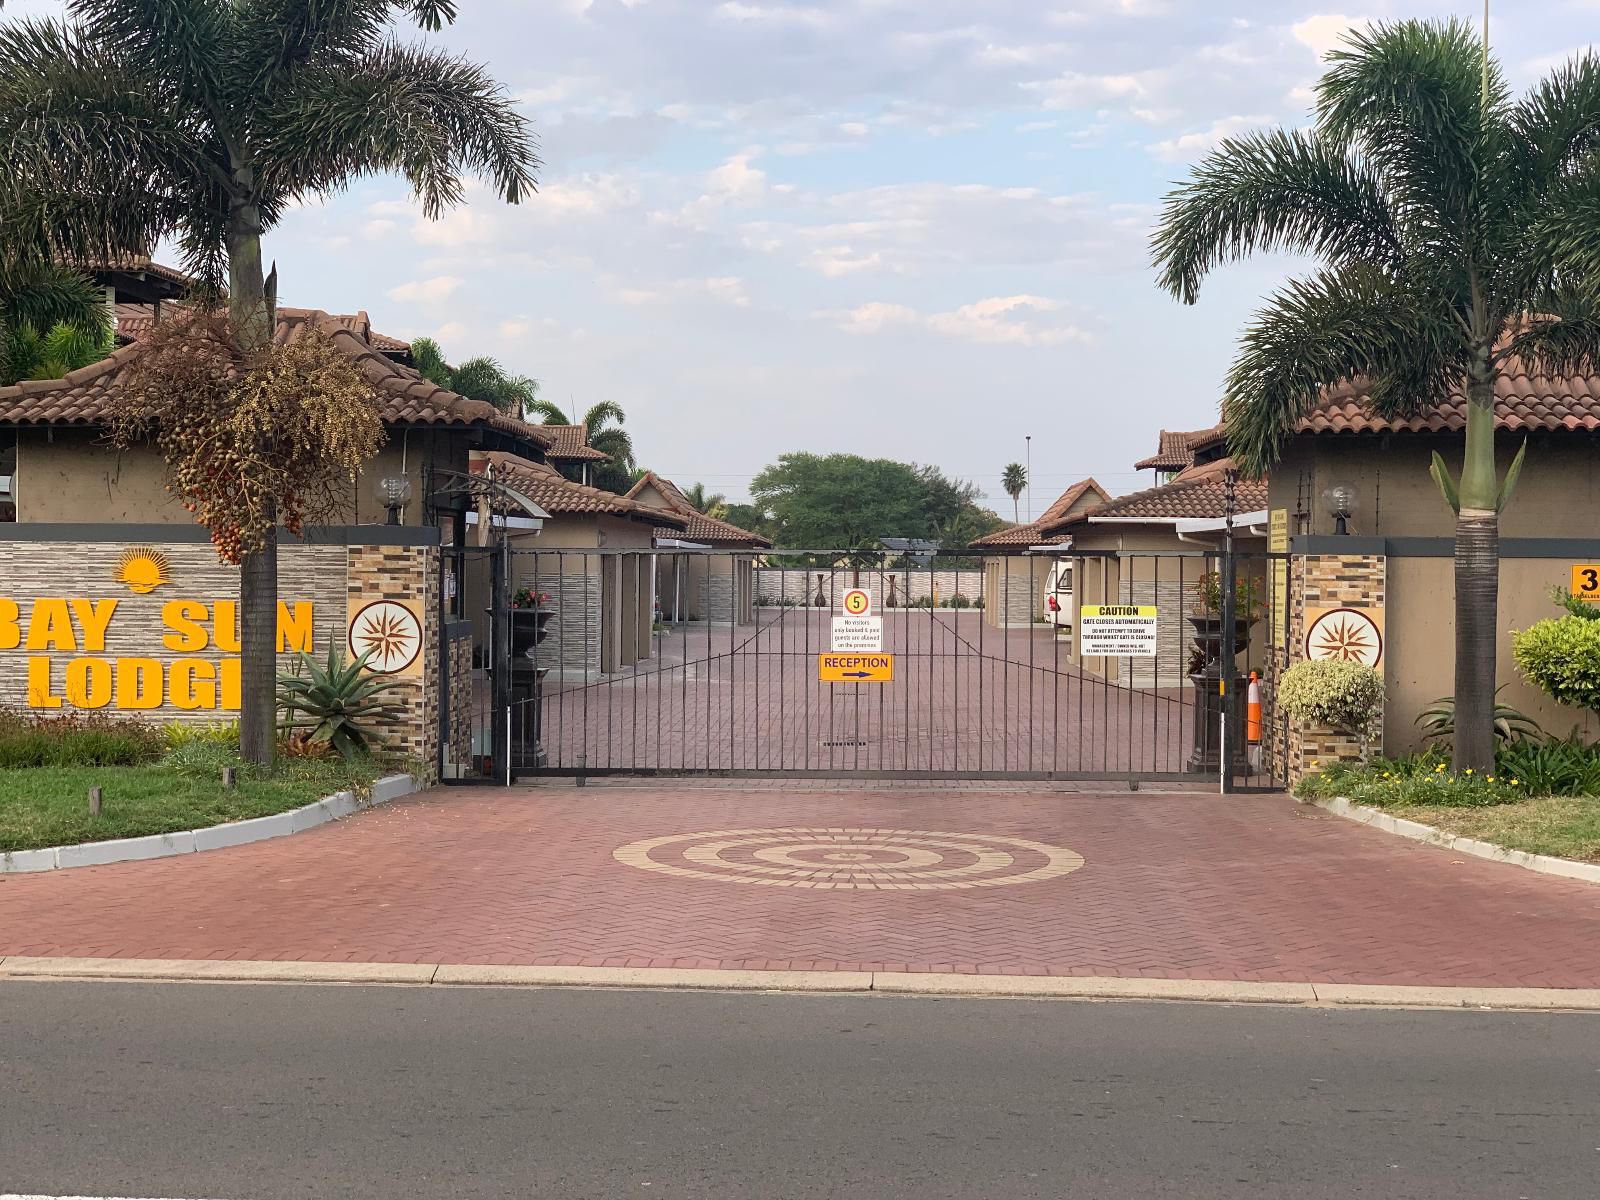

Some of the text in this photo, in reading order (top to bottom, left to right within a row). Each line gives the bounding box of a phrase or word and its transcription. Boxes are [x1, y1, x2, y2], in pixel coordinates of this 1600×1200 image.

[1580, 568, 1598, 592] 3
[853, 596, 861, 609] 5
[1099, 606, 1139, 616] CAUTION
[162, 600, 314, 654] SUN
[824, 657, 888, 668] RECEPTION
